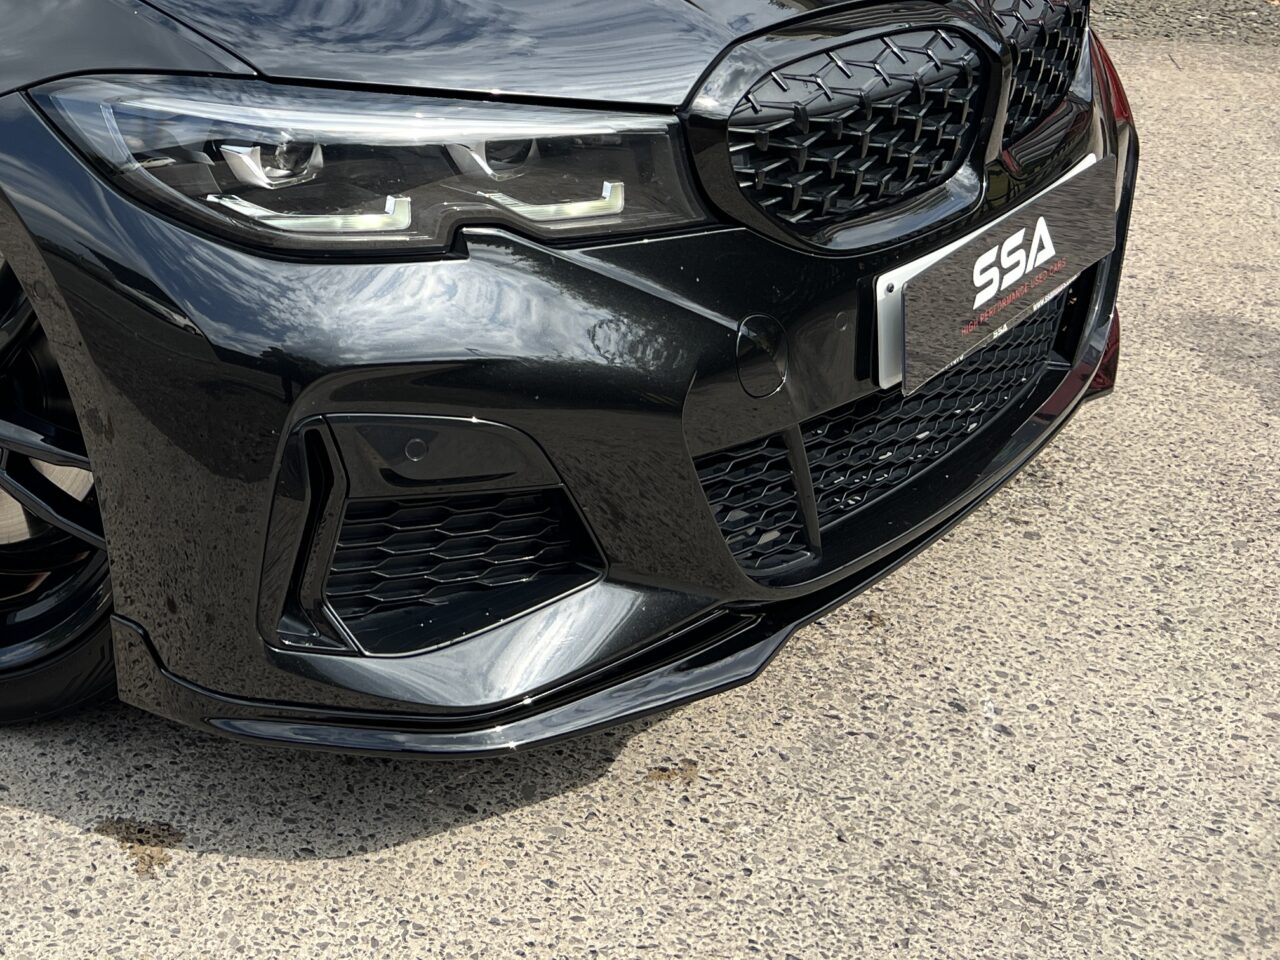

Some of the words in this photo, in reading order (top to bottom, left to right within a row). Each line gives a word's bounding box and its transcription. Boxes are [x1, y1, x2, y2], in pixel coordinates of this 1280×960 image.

[960, 319, 979, 336] HIGH
[979, 282, 1029, 323] PERFORMANCE
[1030, 270, 1047, 288] USED
[1048, 257, 1067, 275] CARS
[972, 216, 1056, 310] SSA
[993, 323, 1008, 339] SSA
